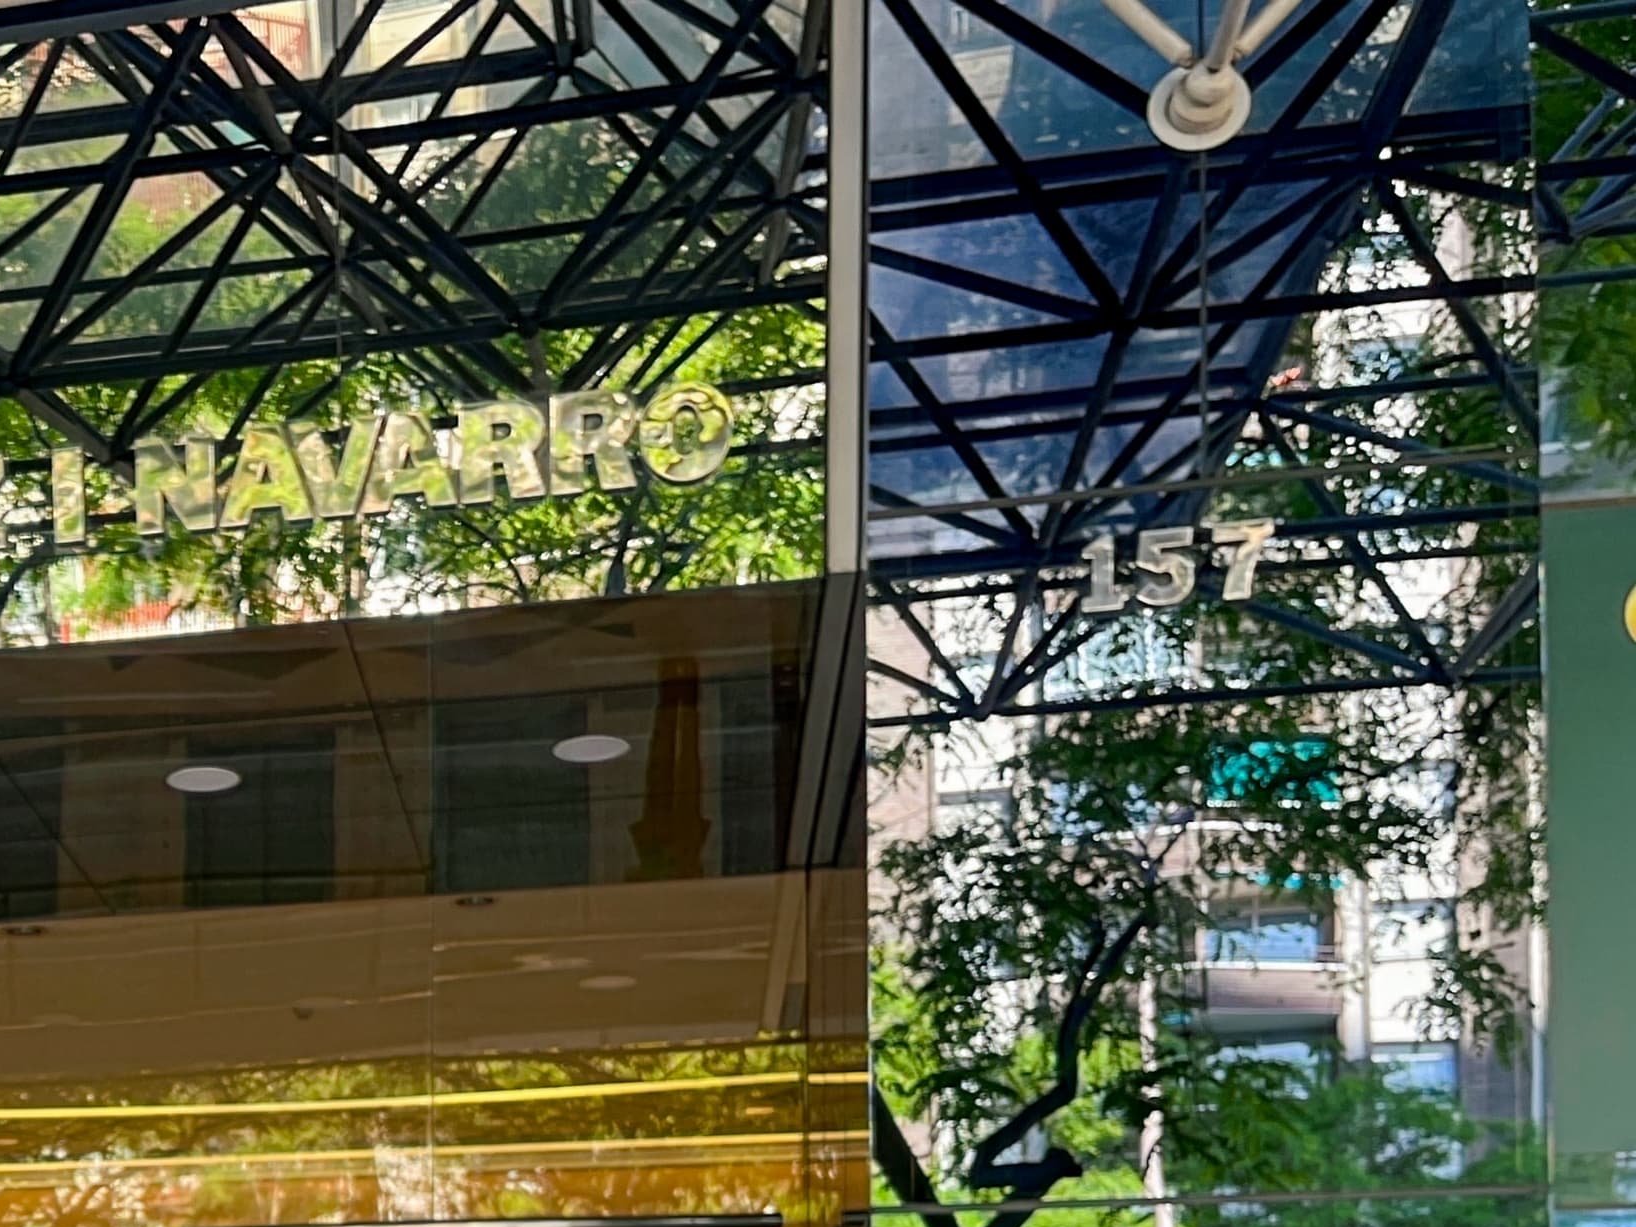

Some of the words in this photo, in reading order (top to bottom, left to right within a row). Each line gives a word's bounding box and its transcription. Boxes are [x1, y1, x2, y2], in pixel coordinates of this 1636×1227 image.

[51, 446, 86, 544] I
[134, 381, 734, 536] NAVARRO
[1081, 517, 1276, 613] 157
